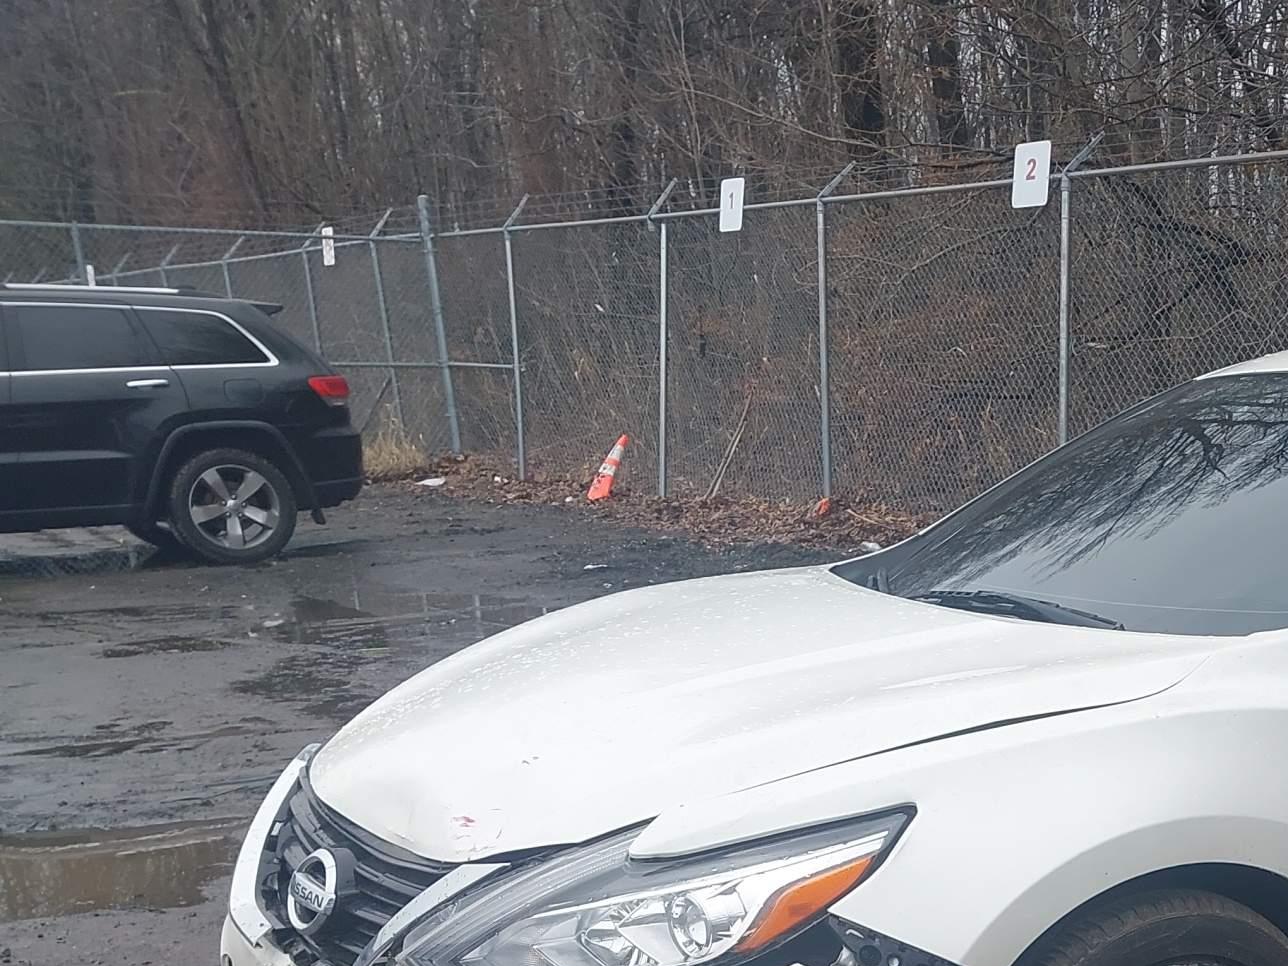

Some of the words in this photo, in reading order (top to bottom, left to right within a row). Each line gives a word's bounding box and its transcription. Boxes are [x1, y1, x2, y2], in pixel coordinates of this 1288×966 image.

[1025, 158, 1037, 181] 2
[728, 191, 735, 209] 1
[291, 881, 325, 909] SSAN
